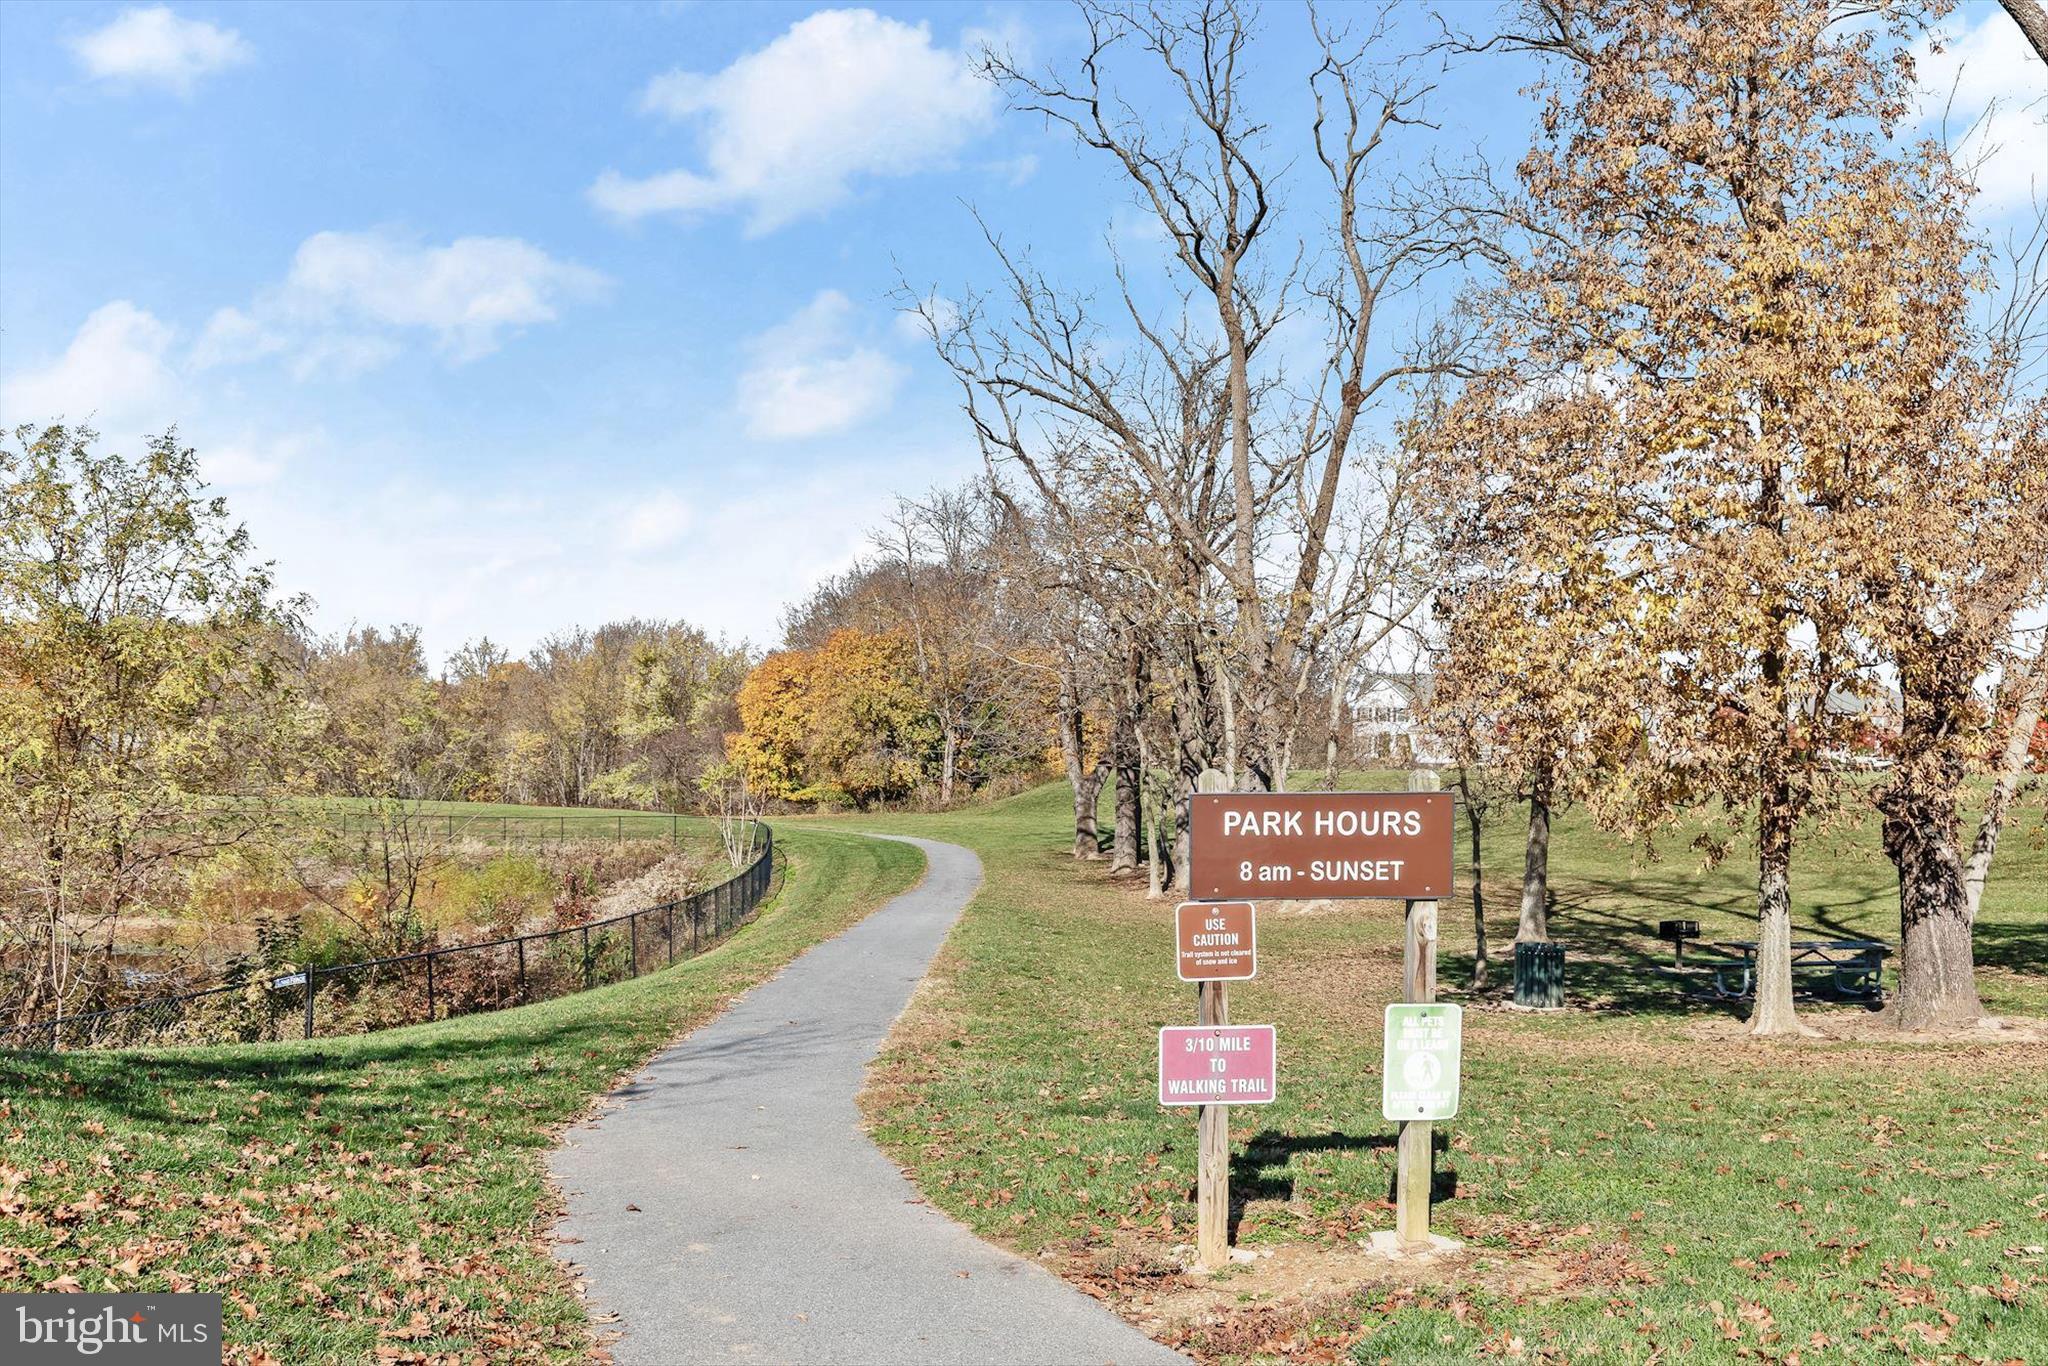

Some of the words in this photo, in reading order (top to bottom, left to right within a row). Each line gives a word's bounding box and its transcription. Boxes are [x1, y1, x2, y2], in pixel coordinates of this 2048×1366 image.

[1224, 811, 1303, 836] PARK
[1315, 810, 1421, 836] HOURS
[1240, 861, 1253, 882] 8
[1259, 866, 1292, 881] am
[1311, 860, 1404, 881] SUNSET
[1205, 918, 1227, 931] USE
[1193, 933, 1239, 947] CAUTION
[1421, 1016, 1445, 1027] PETS
[1185, 1037, 1214, 1052] 3/10
[1219, 1036, 1250, 1051] MILE
[1210, 1058, 1226, 1074] TO
[1168, 1079, 1227, 1095] WALKING
[1231, 1077, 1267, 1093] TRAIL
